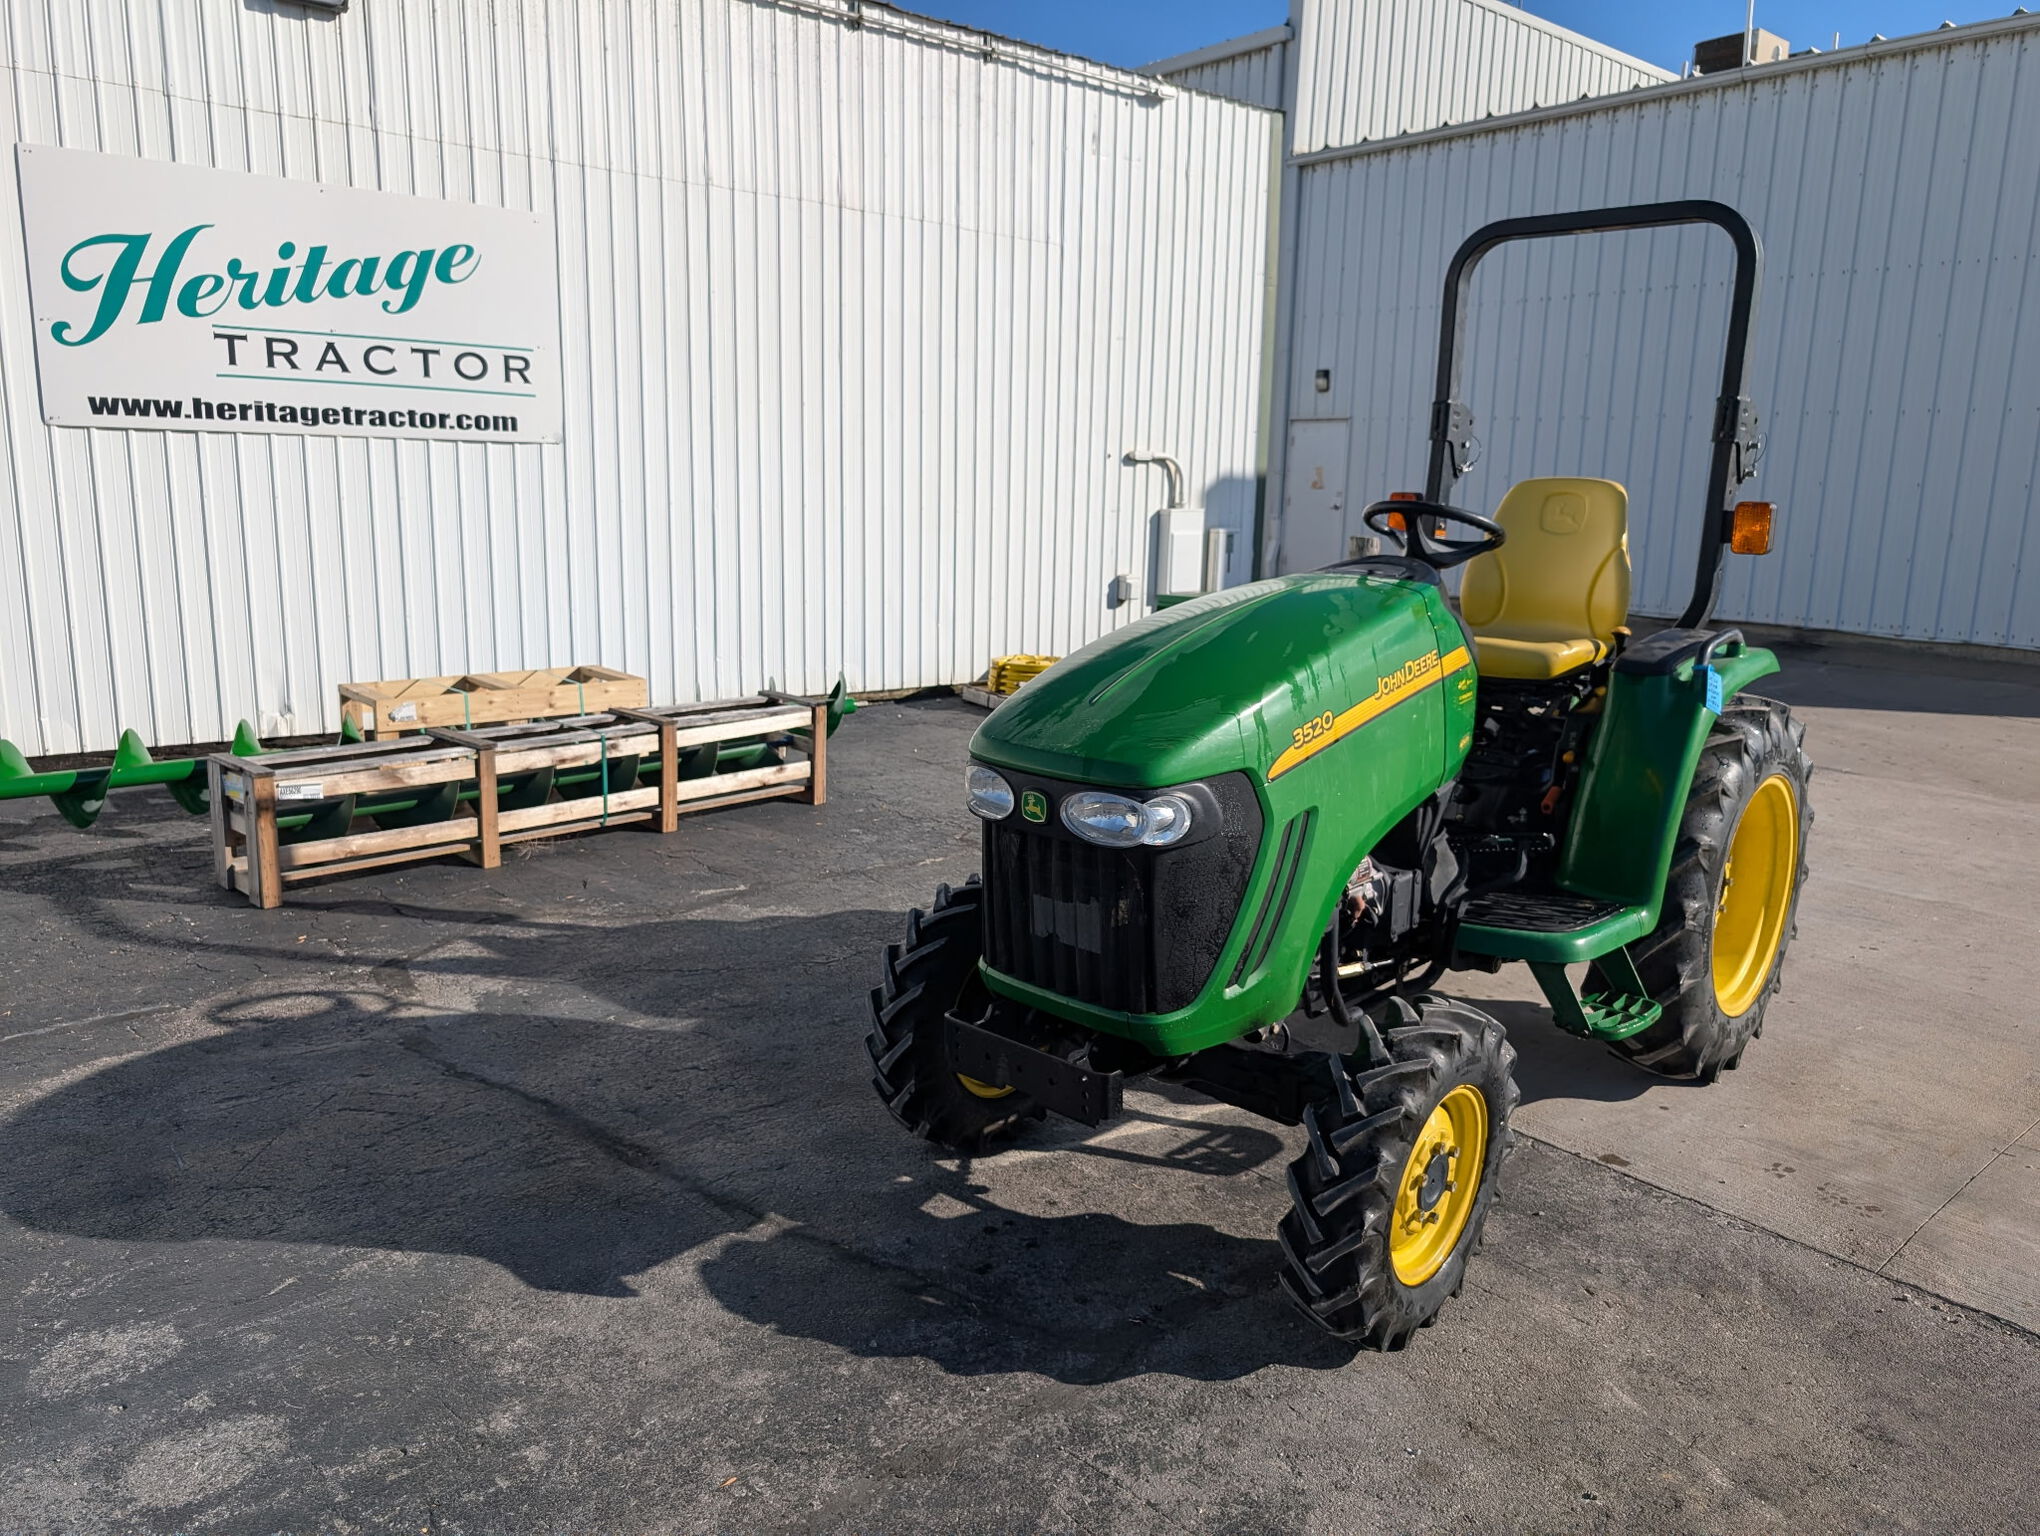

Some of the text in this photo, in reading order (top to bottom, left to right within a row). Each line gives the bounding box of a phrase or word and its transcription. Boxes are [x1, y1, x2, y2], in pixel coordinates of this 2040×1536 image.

[50, 224, 482, 346] Heritage
[213, 331, 532, 384] TRACTOR
[87, 395, 518, 432] www.heritagetractor.com
[1374, 649, 1438, 699] JOHN DEERE
[1292, 709, 1333, 748] 3520
